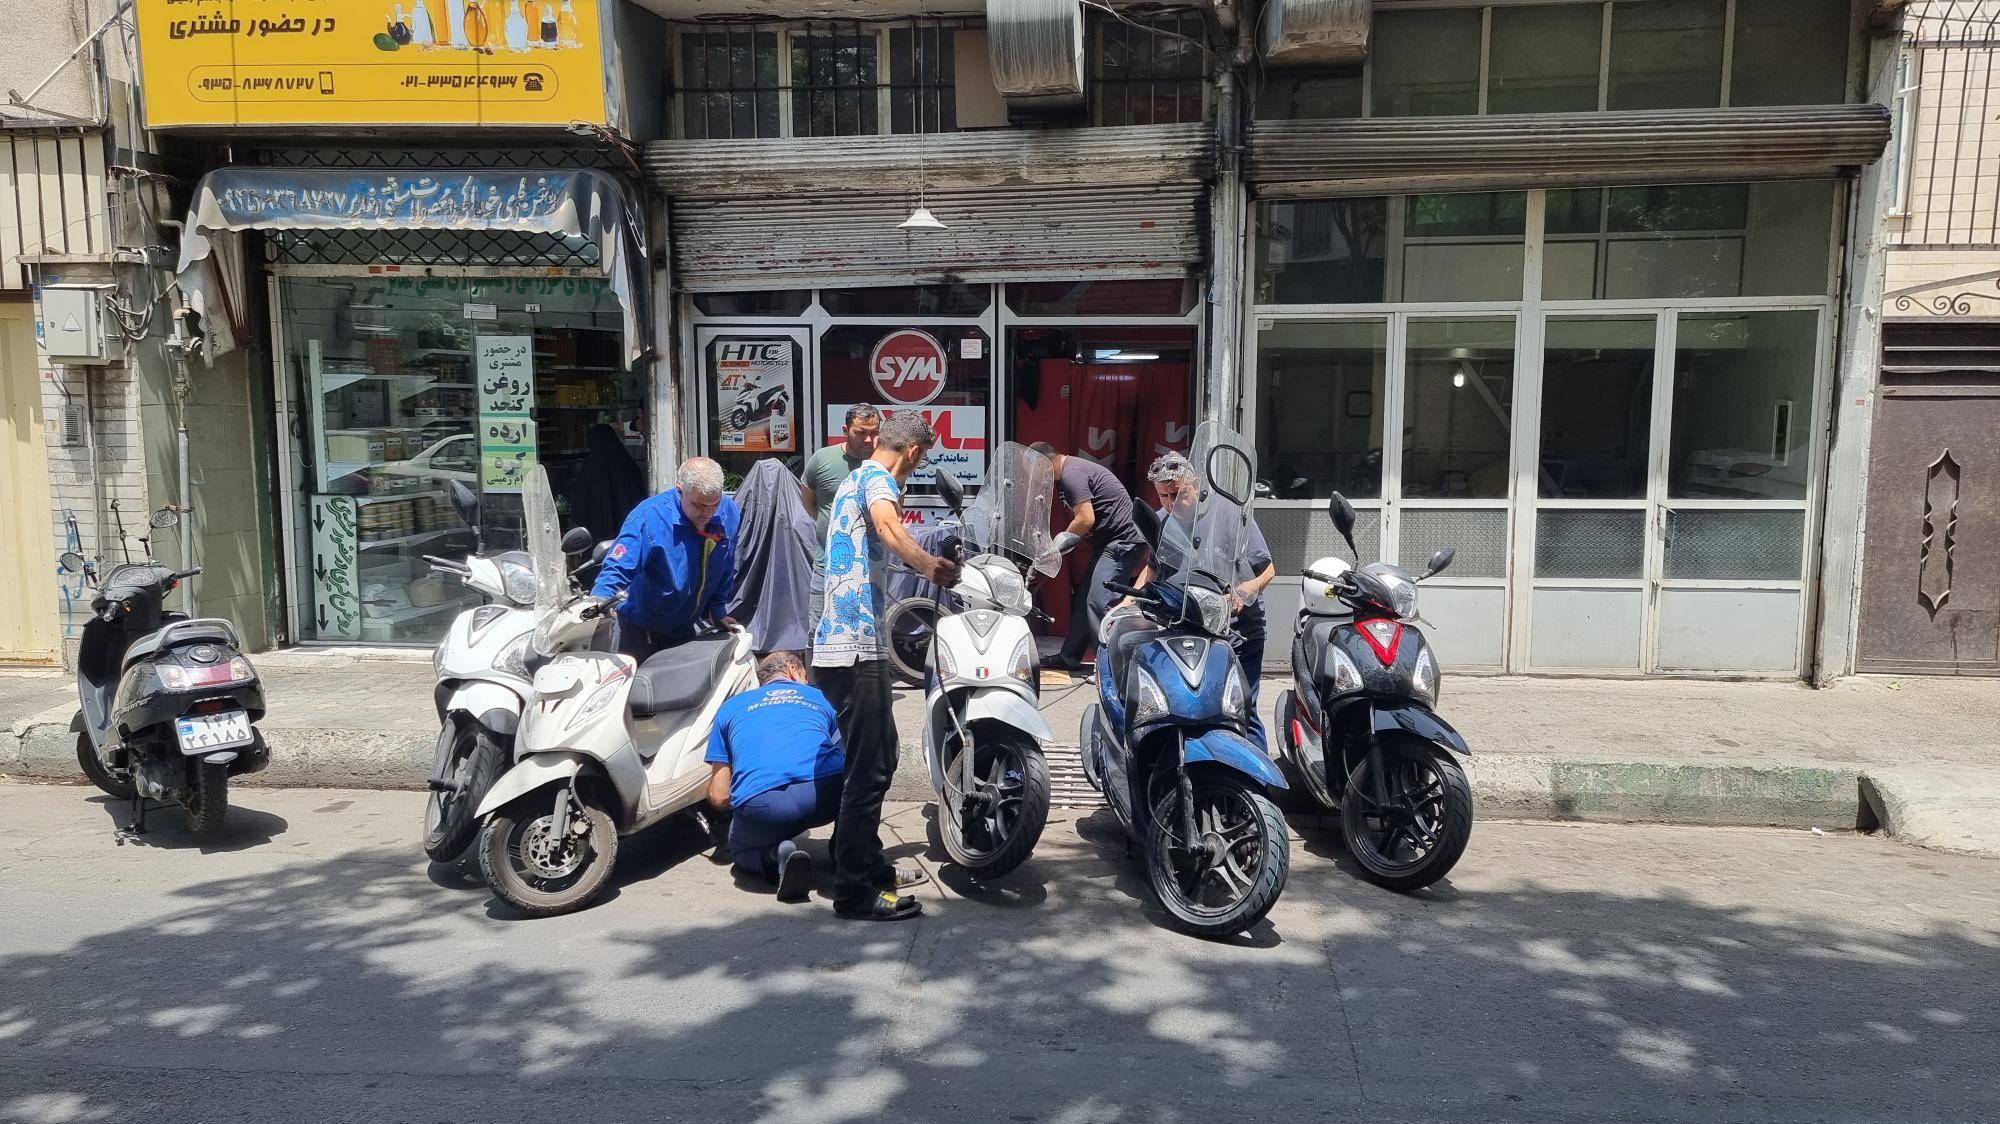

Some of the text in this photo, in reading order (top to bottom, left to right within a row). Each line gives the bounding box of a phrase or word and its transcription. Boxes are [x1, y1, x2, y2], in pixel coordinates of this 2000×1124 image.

[169, 11, 336, 40] در حضور مشتری
[483, 343, 527, 357] در حضور
[720, 343, 782, 361] HTC
[489, 358, 522, 370] مشتری
[875, 356, 942, 388] SYM
[483, 372, 531, 396] روغن
[489, 423, 527, 445] ارده
[929, 452, 969, 465] نمایندگی
[185, 728, 247, 748] ۲۴۱۸۵
